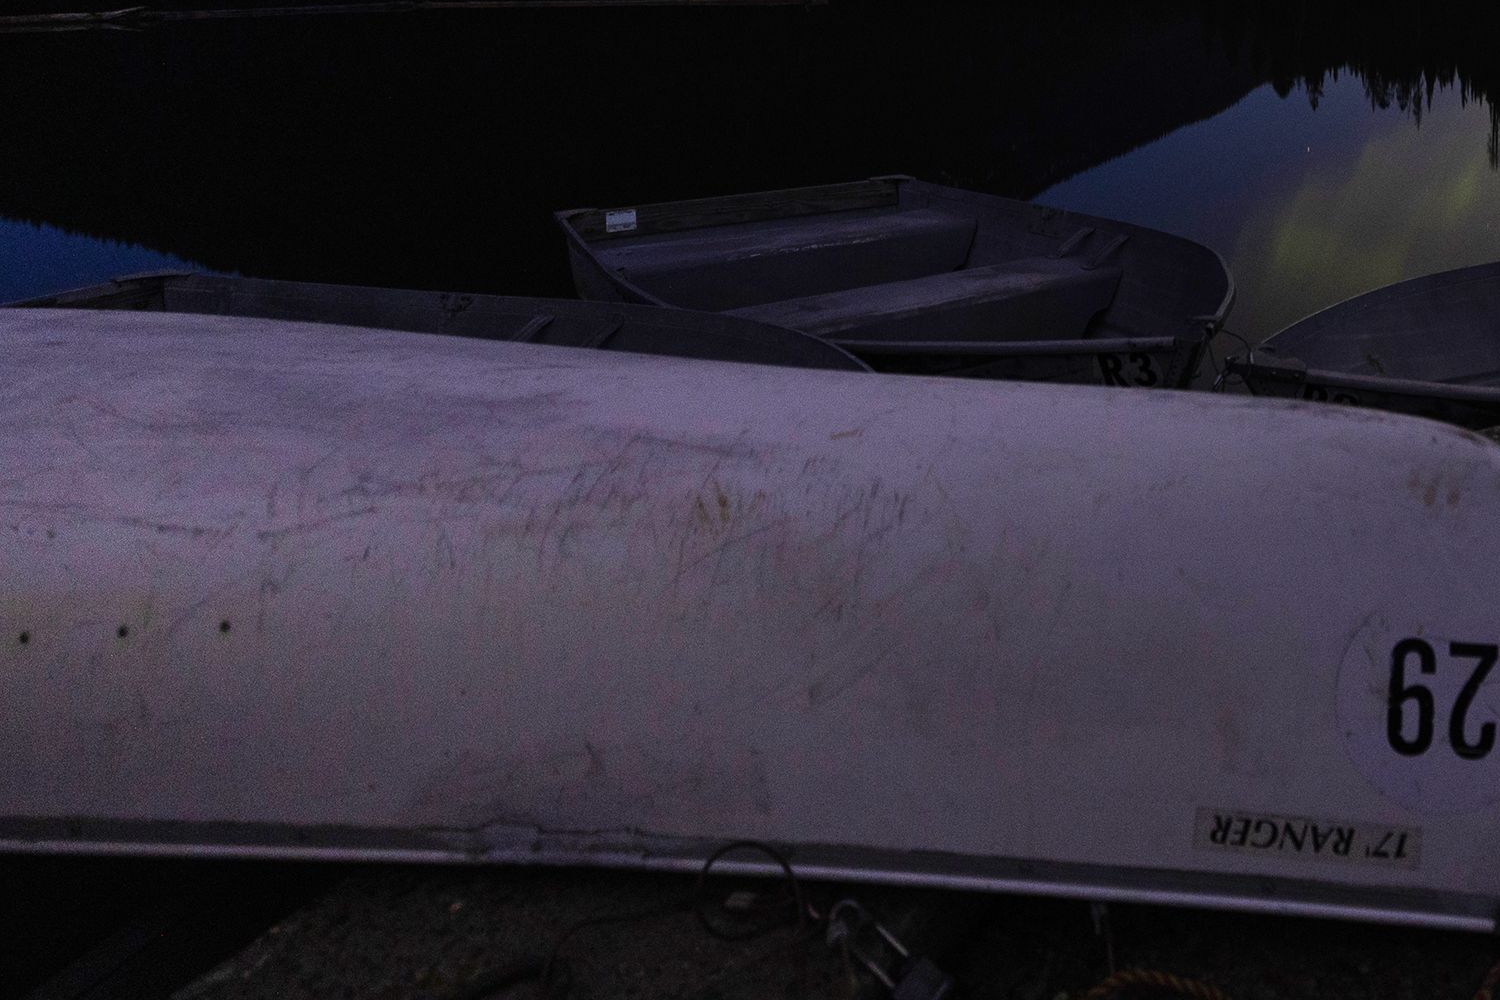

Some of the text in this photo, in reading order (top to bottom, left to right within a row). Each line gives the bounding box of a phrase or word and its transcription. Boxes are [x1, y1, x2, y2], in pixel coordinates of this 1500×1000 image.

[1098, 352, 1157, 387] R3
[1387, 637, 1499, 760] 29
[1209, 815, 1408, 859] 17' RANGER
